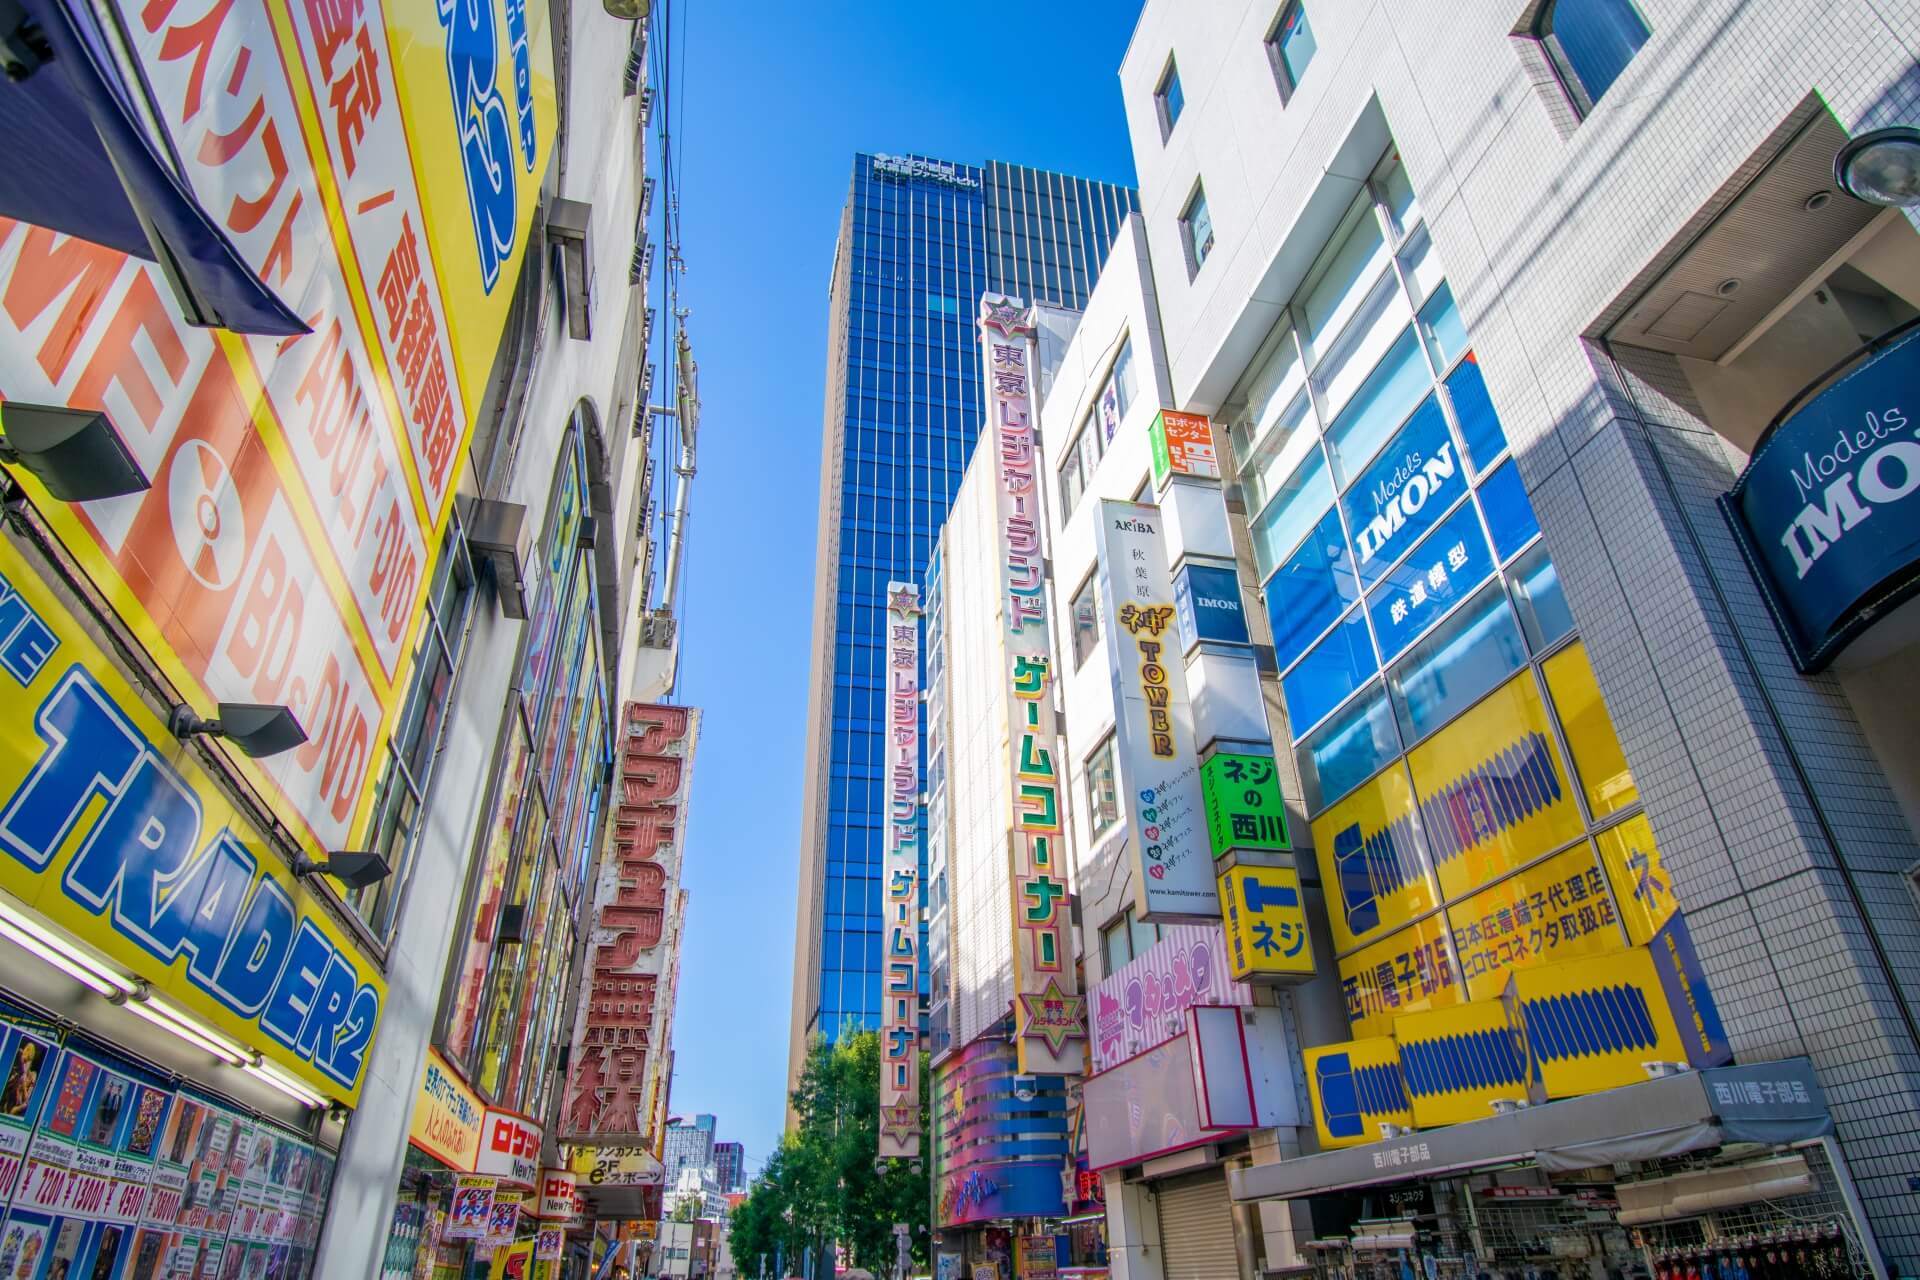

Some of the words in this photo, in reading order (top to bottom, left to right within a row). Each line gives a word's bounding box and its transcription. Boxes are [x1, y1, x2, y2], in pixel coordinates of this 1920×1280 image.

[377, 210, 457, 500] 高額買取
[1165, 416, 1207, 431] ロボット
[1166, 426, 1211, 440] センター
[1790, 407, 1908, 503] Models
[992, 343, 1045, 634] 東京レジャーランド
[1356, 441, 1455, 565] IMON
[1373, 451, 1422, 513] Models
[1781, 428, 1920, 580] IMO
[1132, 547, 1151, 598] 秋葉原
[1197, 597, 1239, 612] IMON
[1391, 540, 1469, 625] 鉄道模型
[892, 625, 918, 852] 東京レジャーランド
[1224, 760, 1272, 786] ネジ
[1013, 655, 1064, 967] ゲームコーナー
[1230, 813, 1287, 844] 西川
[1244, 789, 1263, 808] の
[0, 662, 379, 1093] TRADER2
[1149, 886, 1217, 899] www.kamitower.com
[1456, 870, 1606, 953] 日本圧着端子代理店
[1252, 920, 1304, 958] ネジ
[1463, 897, 1617, 979] ヒロセコネクタ取扱店
[889, 868, 916, 1091] ゲームコーナー
[1343, 936, 1453, 1022] 西川電子部品
[1713, 1080, 1811, 1105] 西川電子部品
[597, 1159, 620, 1173] 2F
[1373, 1143, 1431, 1169] 西川電子部品
